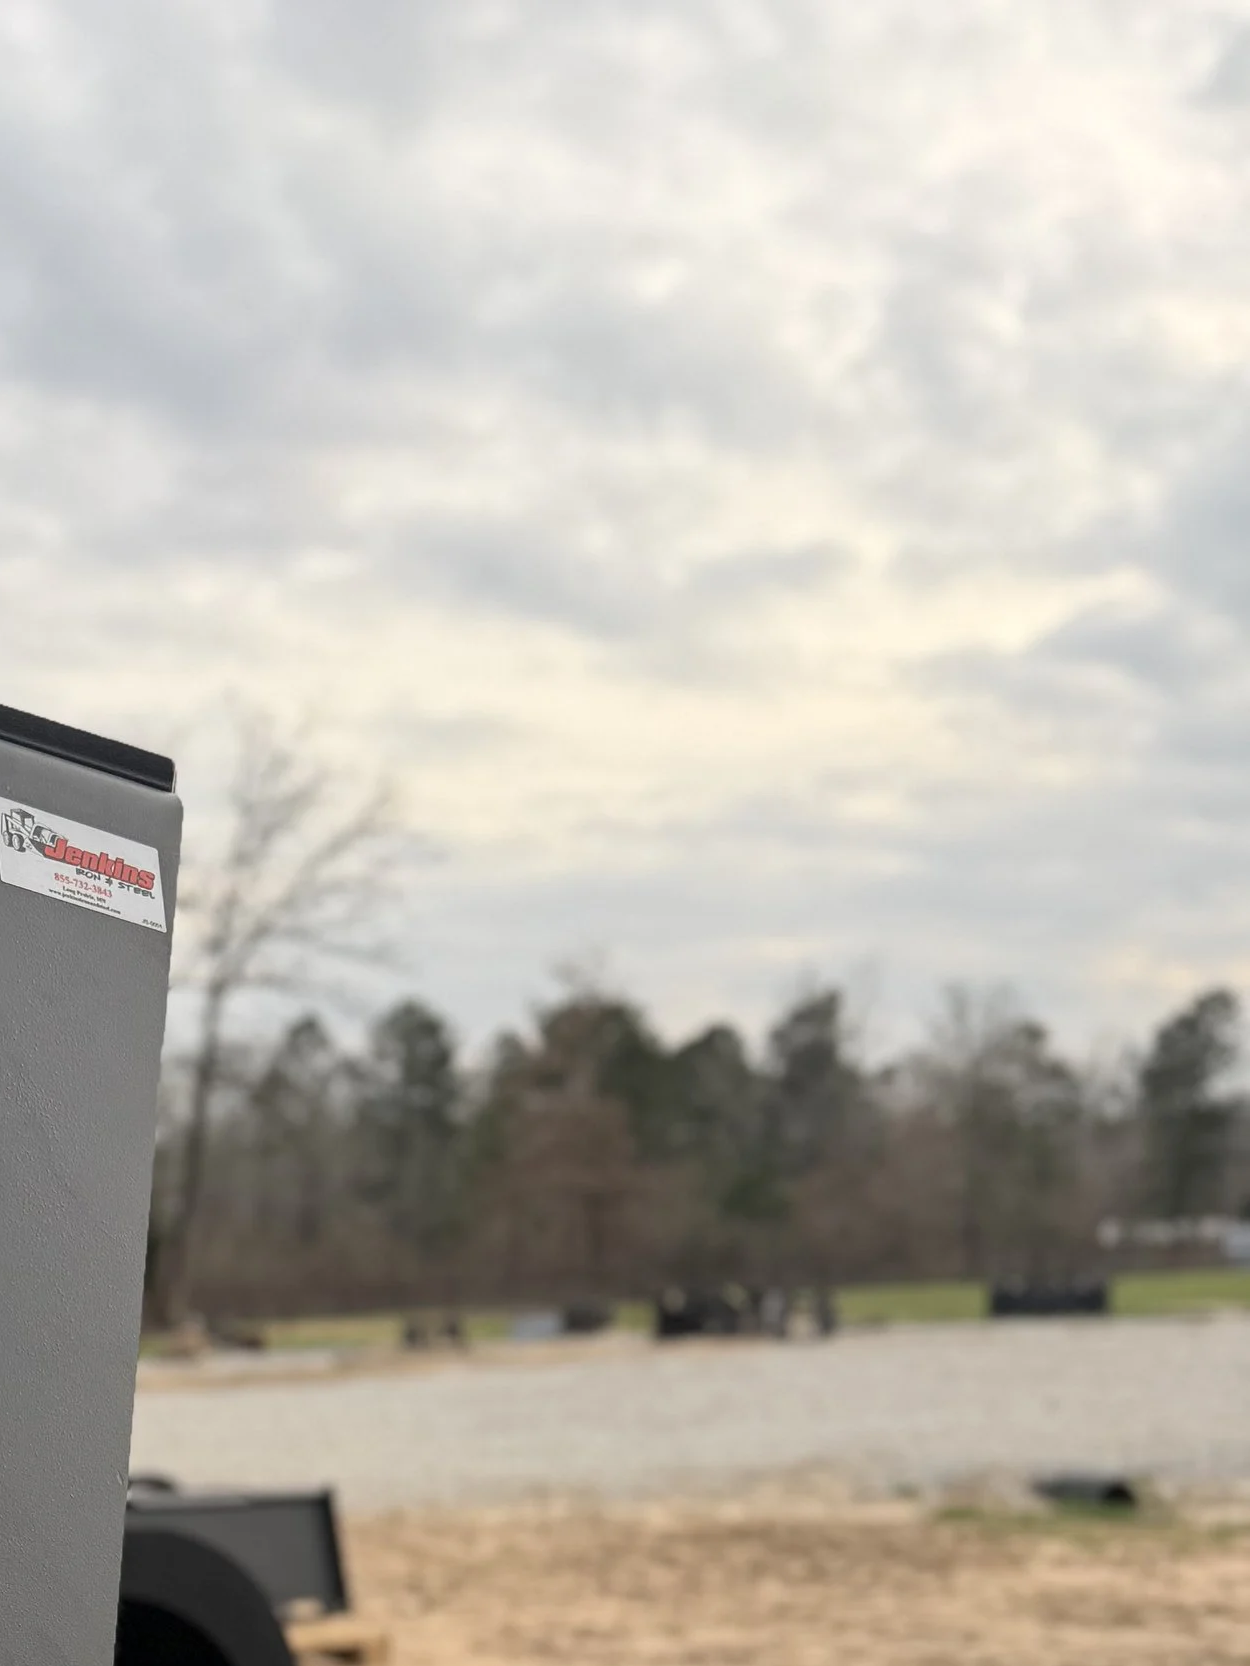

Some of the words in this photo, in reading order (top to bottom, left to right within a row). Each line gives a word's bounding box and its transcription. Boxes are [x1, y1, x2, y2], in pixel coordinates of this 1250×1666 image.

[44, 837, 155, 890] Jenkins
[76, 868, 101, 881] IRON
[118, 882, 155, 899] STEEL
